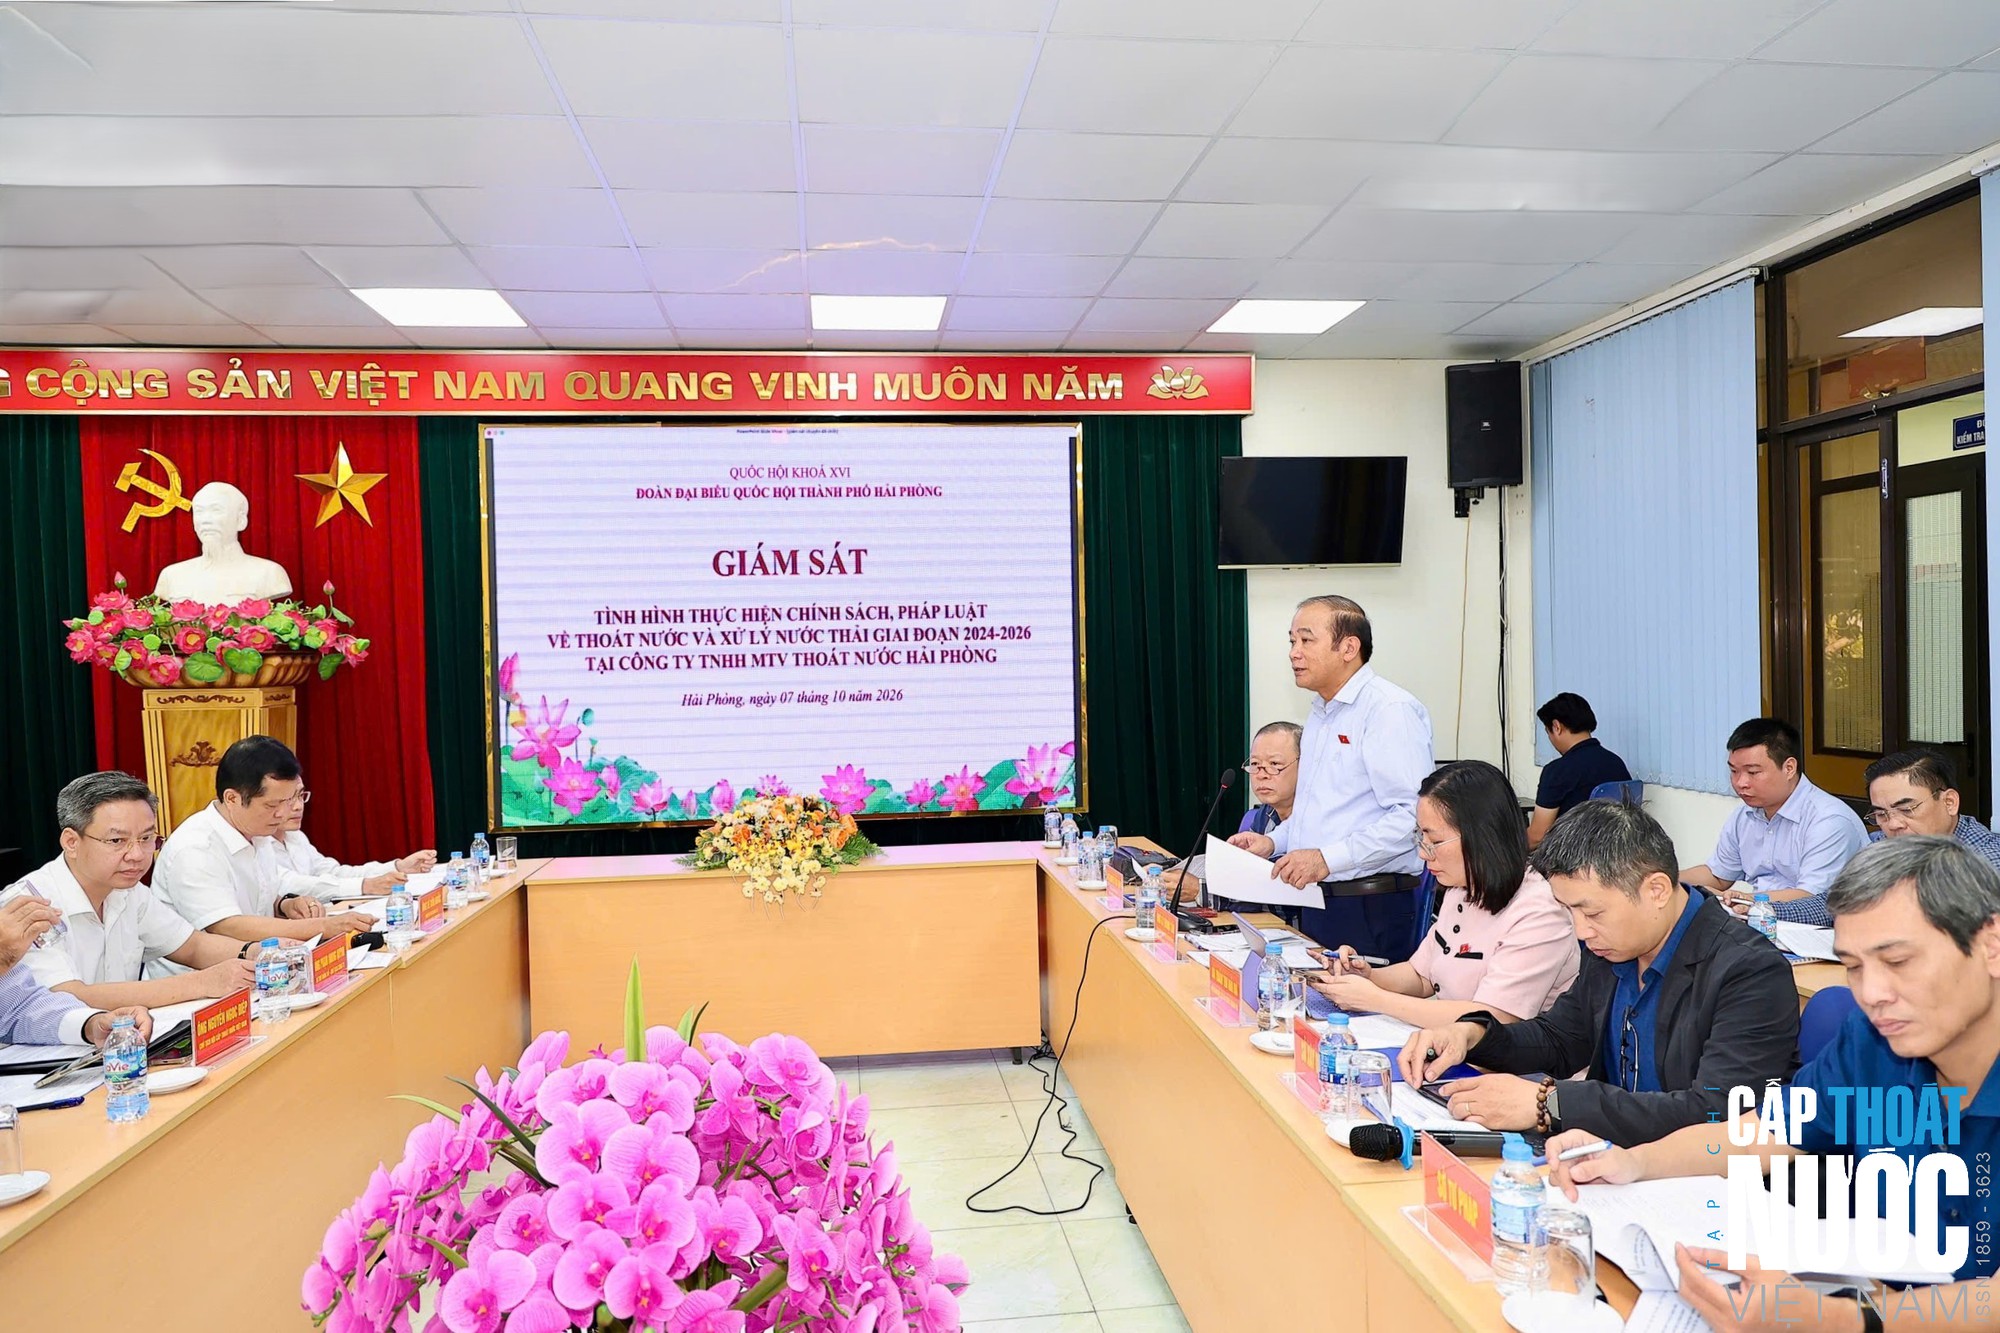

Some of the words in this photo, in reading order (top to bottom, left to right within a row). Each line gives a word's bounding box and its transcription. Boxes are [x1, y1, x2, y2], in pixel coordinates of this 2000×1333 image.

[24, 358, 170, 407] CỘNG
[186, 357, 293, 400] SẢN
[309, 363, 419, 407] VIỆT
[433, 370, 546, 401] NAM
[564, 370, 733, 402] QUANG
[748, 370, 858, 401] VINH
[873, 365, 1008, 401] MUÔN
[1023, 364, 1124, 401] NĂM
[730, 464, 764, 480] QUỐC
[768, 464, 788, 480] HỘI
[792, 464, 826, 478] KHOÁ
[830, 467, 850, 478] XVI
[636, 485, 672, 499] ĐOÀN
[676, 487, 697, 501] ĐẠI
[701, 485, 730, 498] BIỂU
[734, 485, 770, 500] QUỐC
[773, 485, 796, 500] HỘI
[800, 484, 842, 498] THÀNH
[846, 484, 871, 498] PHỐ
[874, 483, 896, 497] HẢI
[900, 483, 942, 497] PHÒNG
[713, 541, 800, 577] GIÁM
[809, 541, 868, 576] SÁT
[594, 606, 636, 625] TÌNH
[641, 605, 685, 625] HÌNH
[689, 606, 737, 626] THỰC
[741, 605, 782, 625] HIỆN
[787, 603, 841, 621] CHÍNH
[845, 602, 894, 622] SÁCH,
[898, 601, 941, 620] PHÁP
[944, 602, 988, 622] LUẬT
[547, 631, 570, 649] VỀ
[575, 629, 635, 648] THOÁT
[639, 629, 688, 647] NƯỚC
[692, 628, 716, 645] VÀ
[720, 627, 746, 645] XỬ
[750, 627, 772, 645] LÝ
[776, 625, 825, 645] NƯỚC
[828, 625, 868, 643] THẢI
[873, 627, 909, 642] GIAI
[913, 626, 959, 645] ĐOẠN
[964, 625, 1031, 641] 2024-2026
[585, 656, 614, 674] TẠI
[619, 652, 668, 671] CÔNG
[672, 655, 694, 670] TY
[698, 653, 746, 669] TNHH
[751, 652, 788, 668] MTV
[792, 648, 850, 666] THOÁT
[854, 647, 902, 666] NƯỚC
[906, 646, 935, 664] HẢI
[940, 645, 997, 663] PHÒNG
[681, 693, 703, 707] Hải
[706, 692, 746, 708] Phòng,
[750, 694, 777, 708] ngày
[780, 691, 794, 704] 07
[797, 691, 829, 706] tháng
[832, 690, 846, 703] 10
[849, 690, 872, 702] năm
[876, 689, 903, 702] 2026
